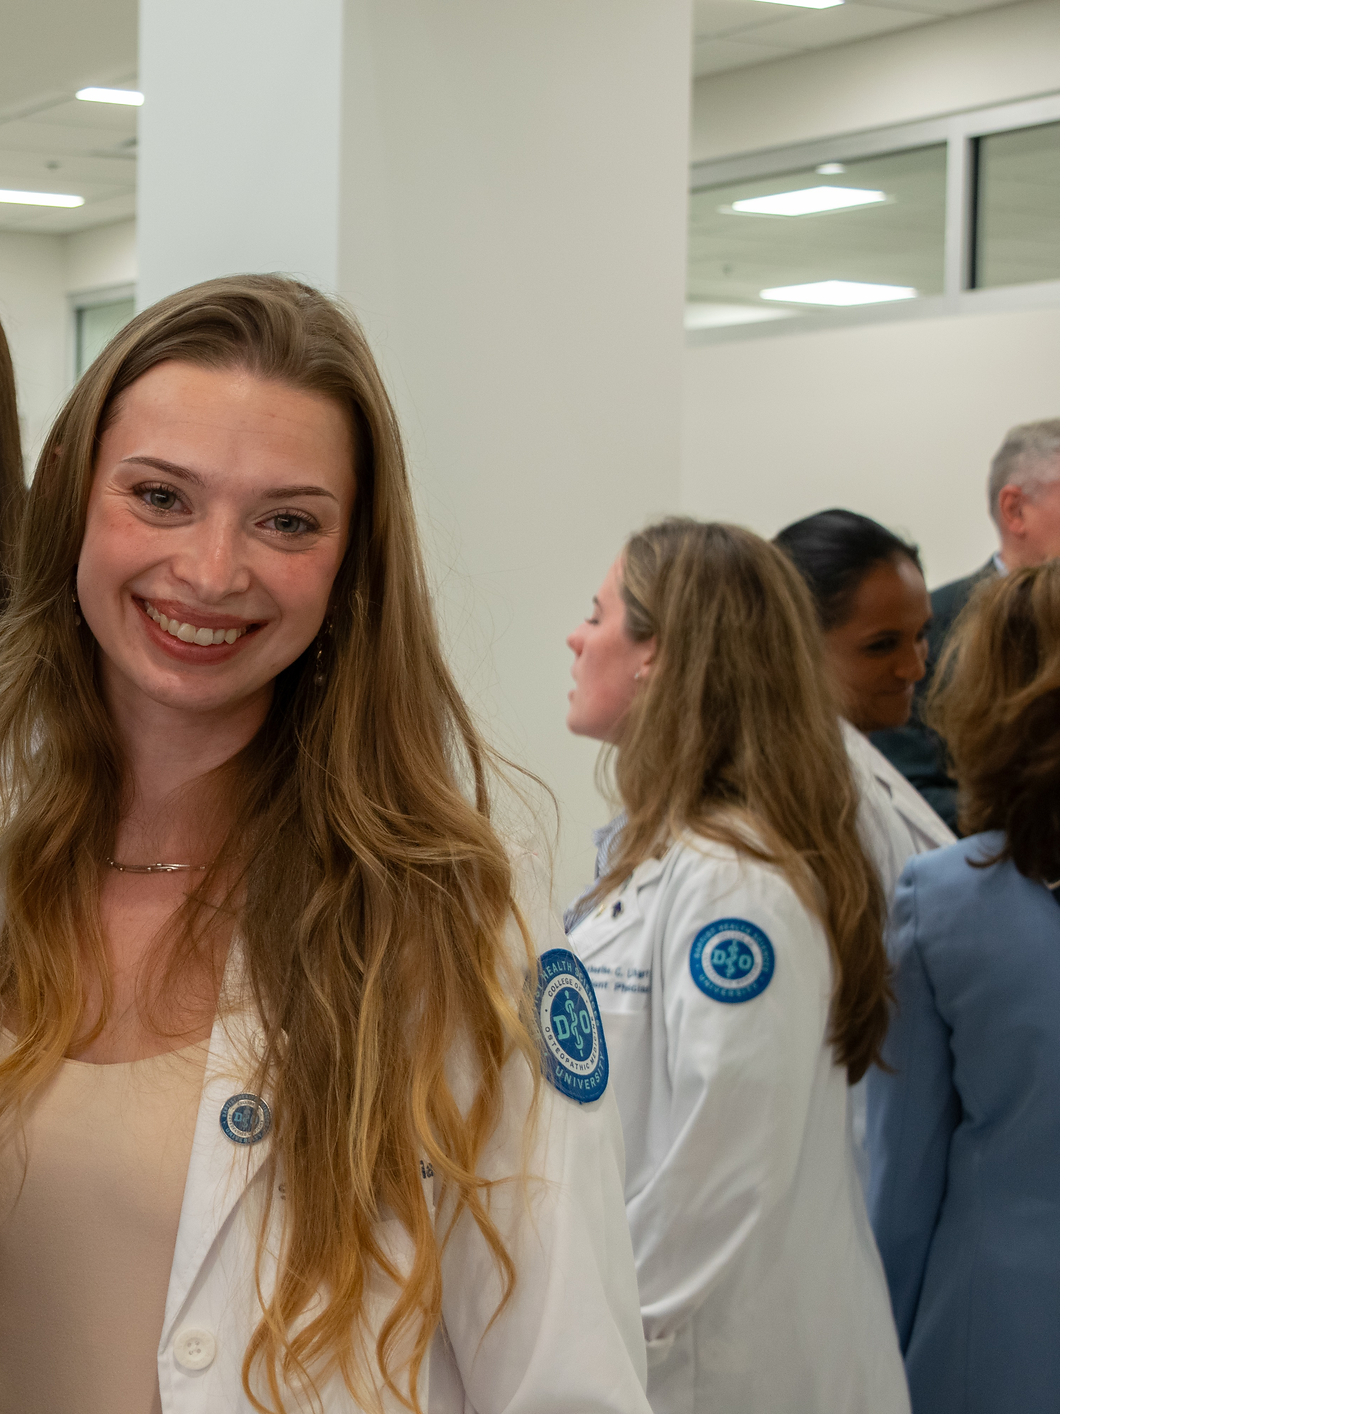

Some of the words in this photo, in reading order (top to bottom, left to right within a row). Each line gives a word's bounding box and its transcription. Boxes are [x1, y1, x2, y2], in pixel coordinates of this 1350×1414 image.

[541, 961, 572, 981] HEALTH
[711, 949, 726, 965] D
[738, 954, 752, 970] O
[548, 977, 573, 997] COLLEGE
[574, 982, 582, 992] OF
[553, 1014, 570, 1040] D
[579, 1009, 591, 1034] O
[544, 1026, 590, 1071] OSTEOPATHIC
[555, 1051, 605, 1090] UNIVERSITY
